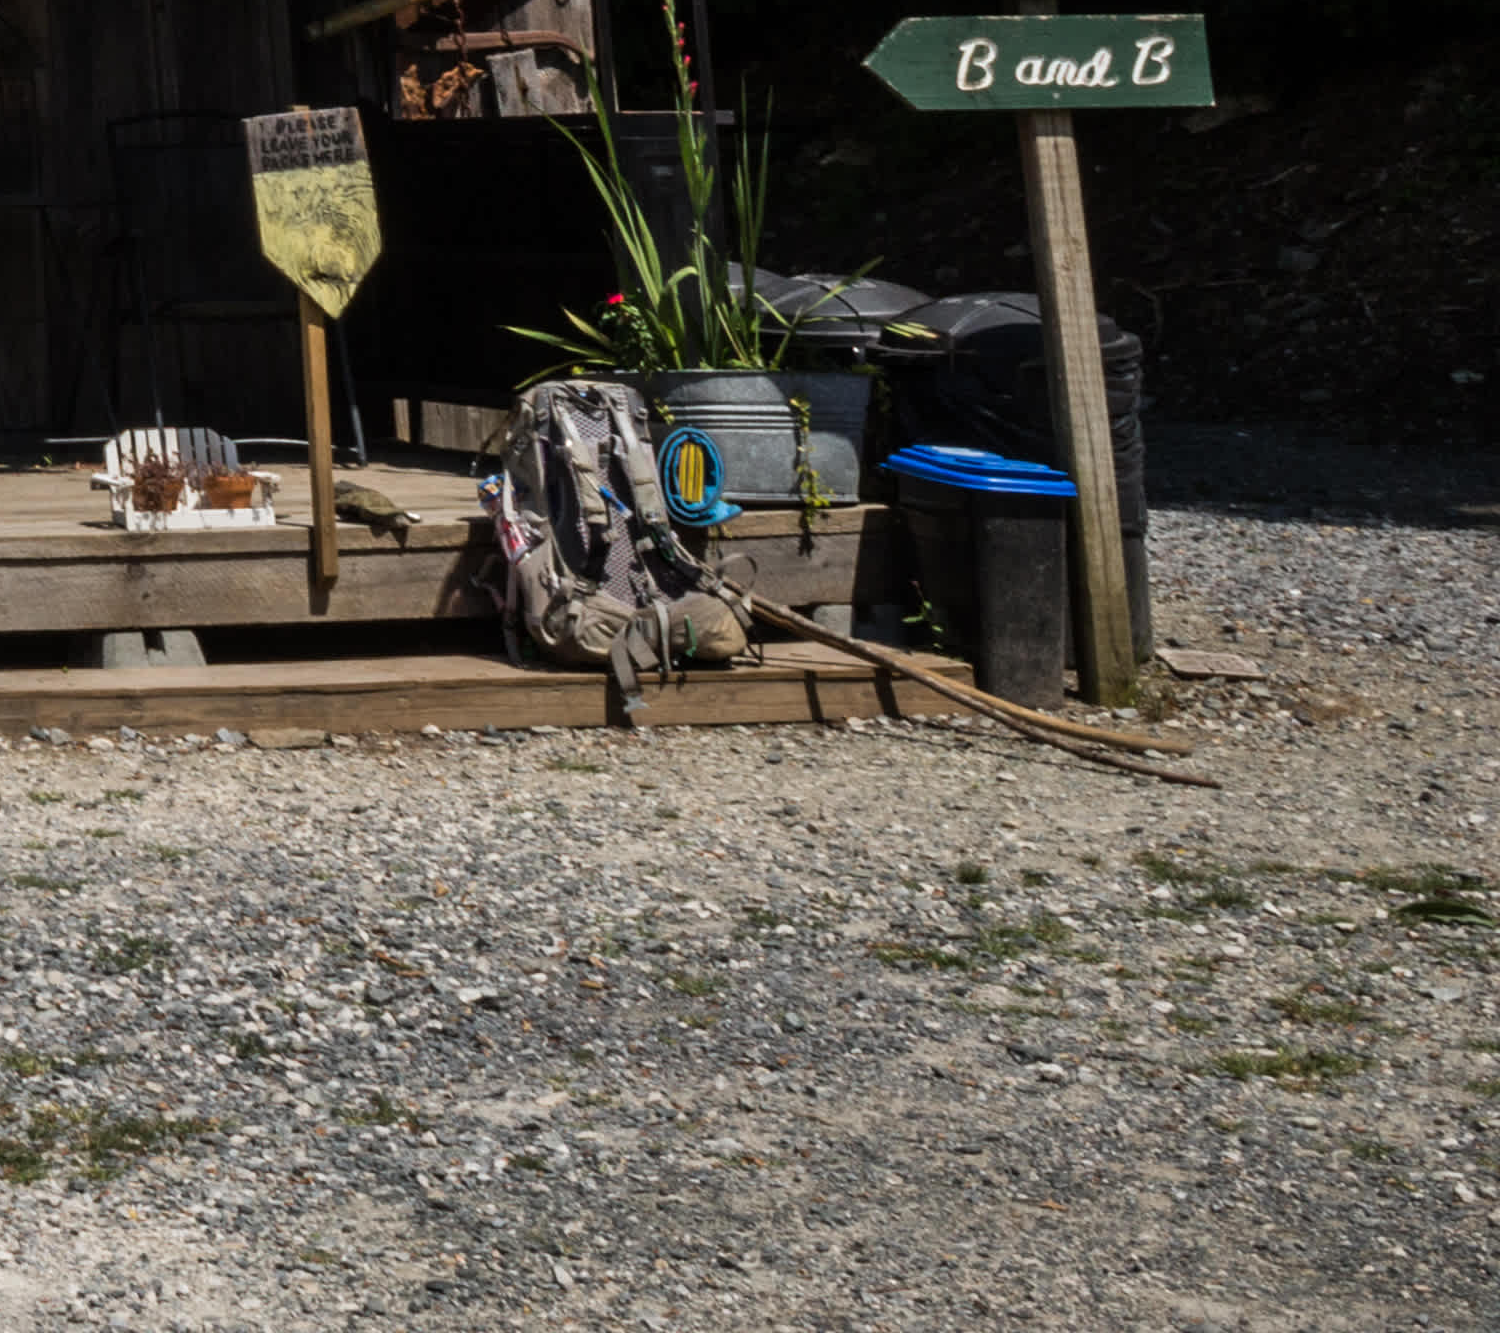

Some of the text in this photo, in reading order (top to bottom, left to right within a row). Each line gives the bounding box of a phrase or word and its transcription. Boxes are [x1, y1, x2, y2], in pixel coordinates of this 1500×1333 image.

[956, 35, 1175, 91] B and B
[275, 115, 336, 134] PLEASE
[261, 130, 353, 154] LEAVE YOUR
[314, 148, 356, 165] HERE
